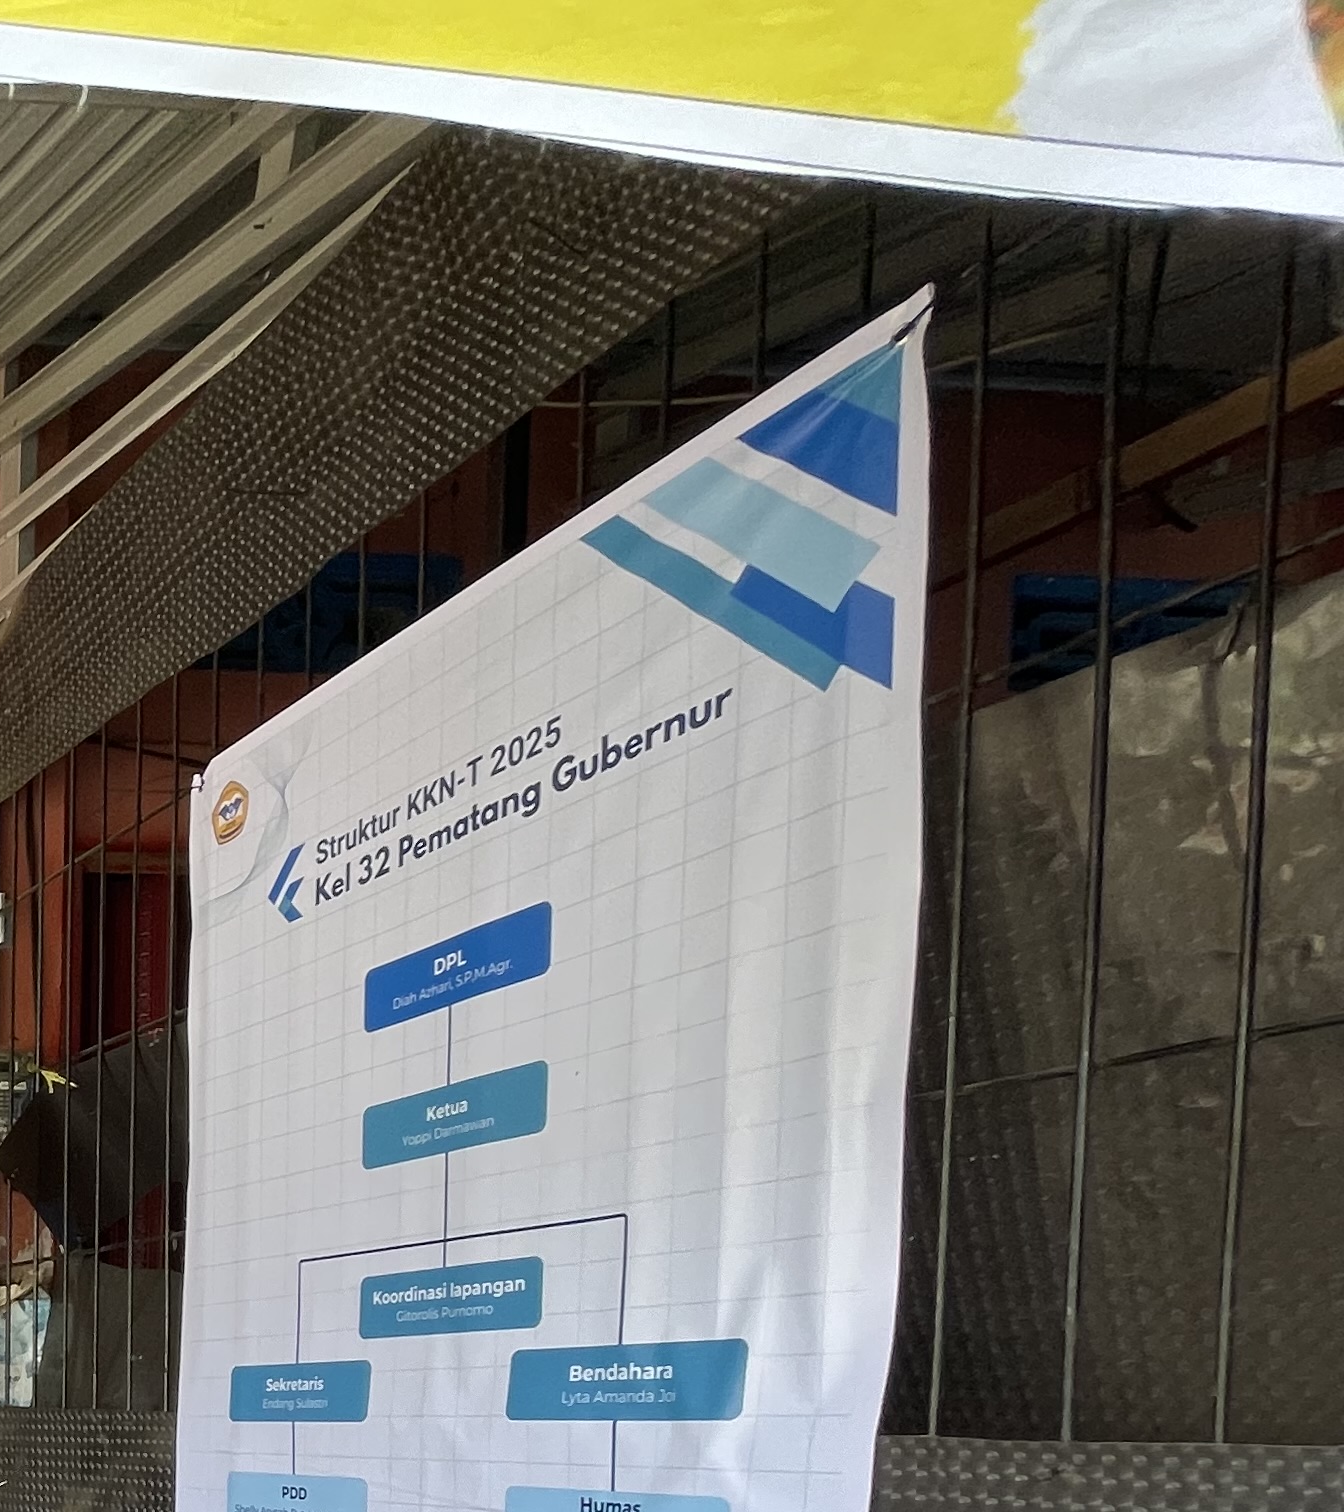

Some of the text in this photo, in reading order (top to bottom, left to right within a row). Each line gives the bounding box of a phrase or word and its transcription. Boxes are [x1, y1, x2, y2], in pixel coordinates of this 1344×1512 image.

[314, 687, 734, 906] Kel 32 Pematang Gubernur
[315, 715, 563, 866] Struktur KKN-T 2025
[433, 949, 468, 976] DPL
[425, 1100, 469, 1122] Ketua
[373, 1278, 526, 1305] Koordinasi lapangan
[568, 1362, 673, 1382] Bendahara
[265, 1376, 324, 1392] Sekretaris
[593, 1389, 655, 1404] Amanda
[281, 1485, 308, 1500] PDD
